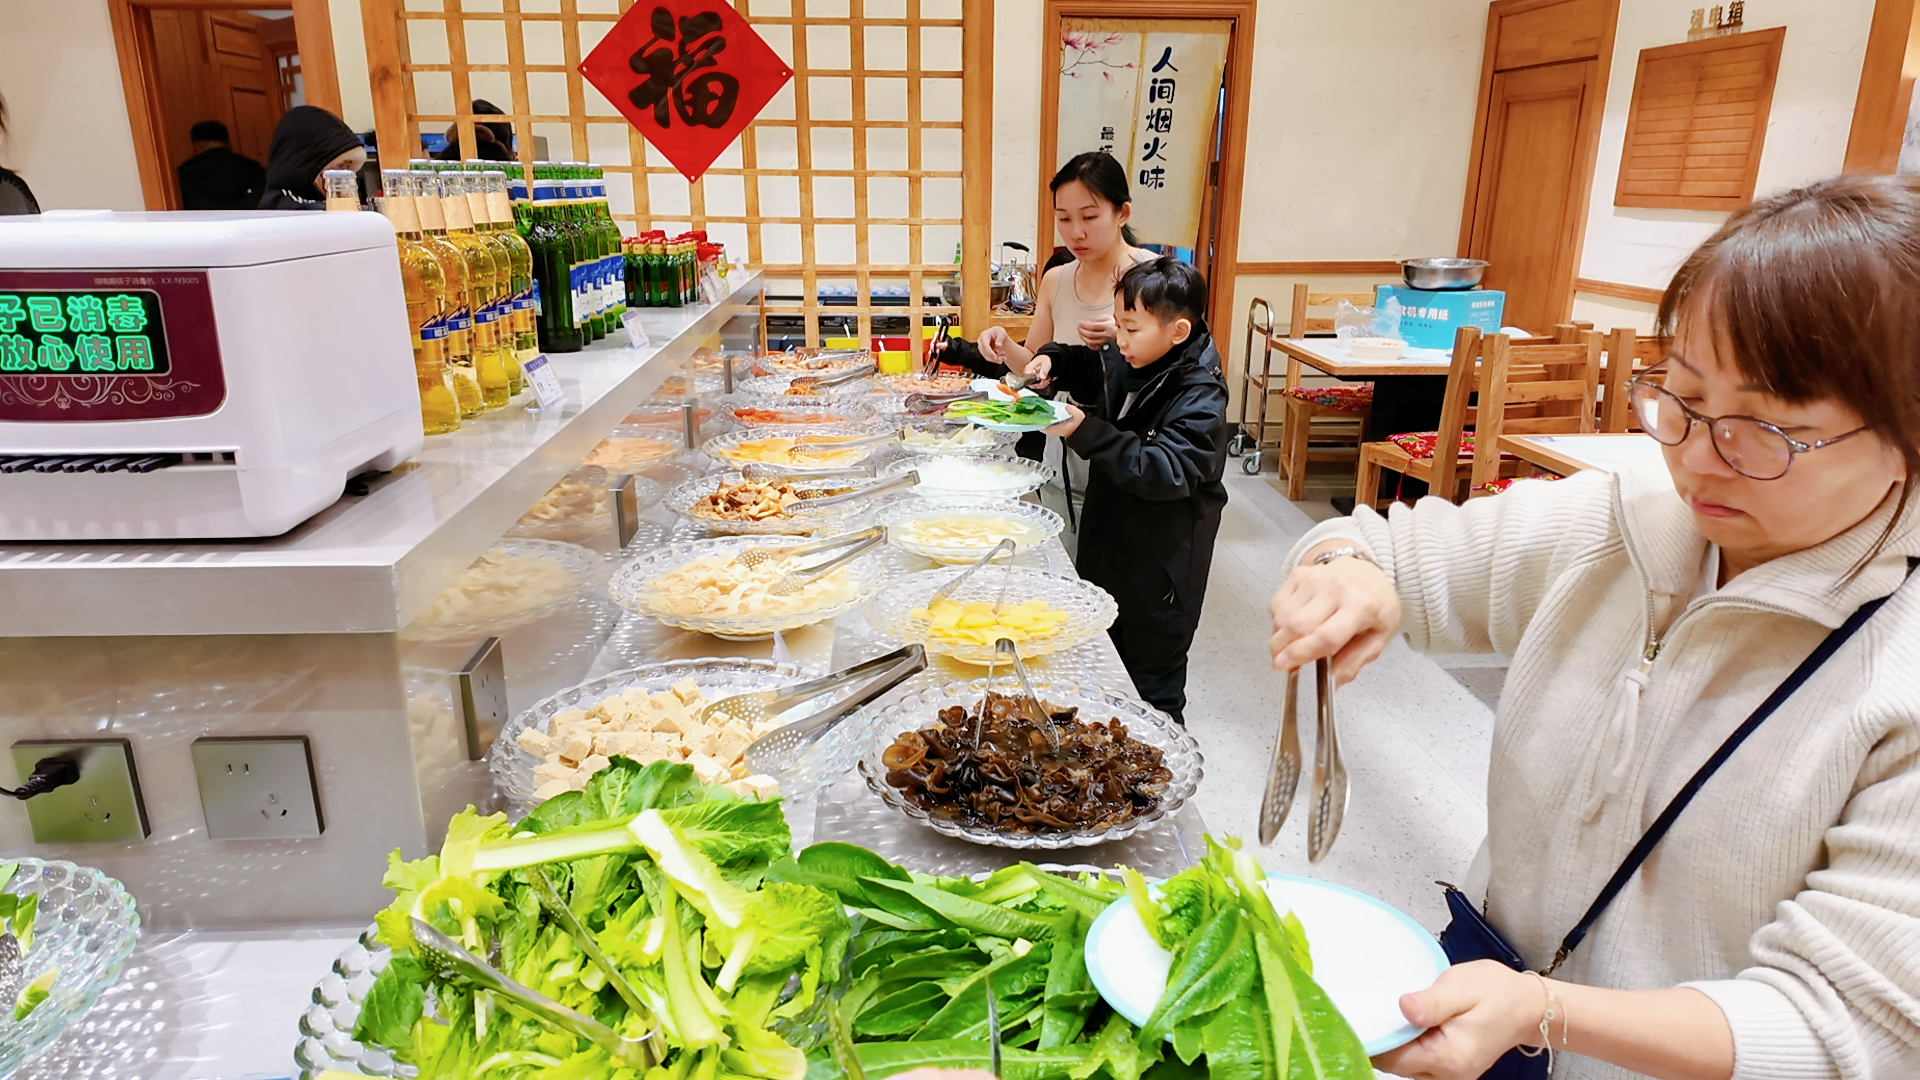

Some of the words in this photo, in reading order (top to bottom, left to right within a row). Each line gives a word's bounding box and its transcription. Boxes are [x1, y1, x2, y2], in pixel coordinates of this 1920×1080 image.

[1690, 0, 1745, 29] 强电箱
[628, 6, 740, 130] 福
[1139, 46, 1179, 190] 人间烟火味
[0, 334, 154, 372] 放心使用
